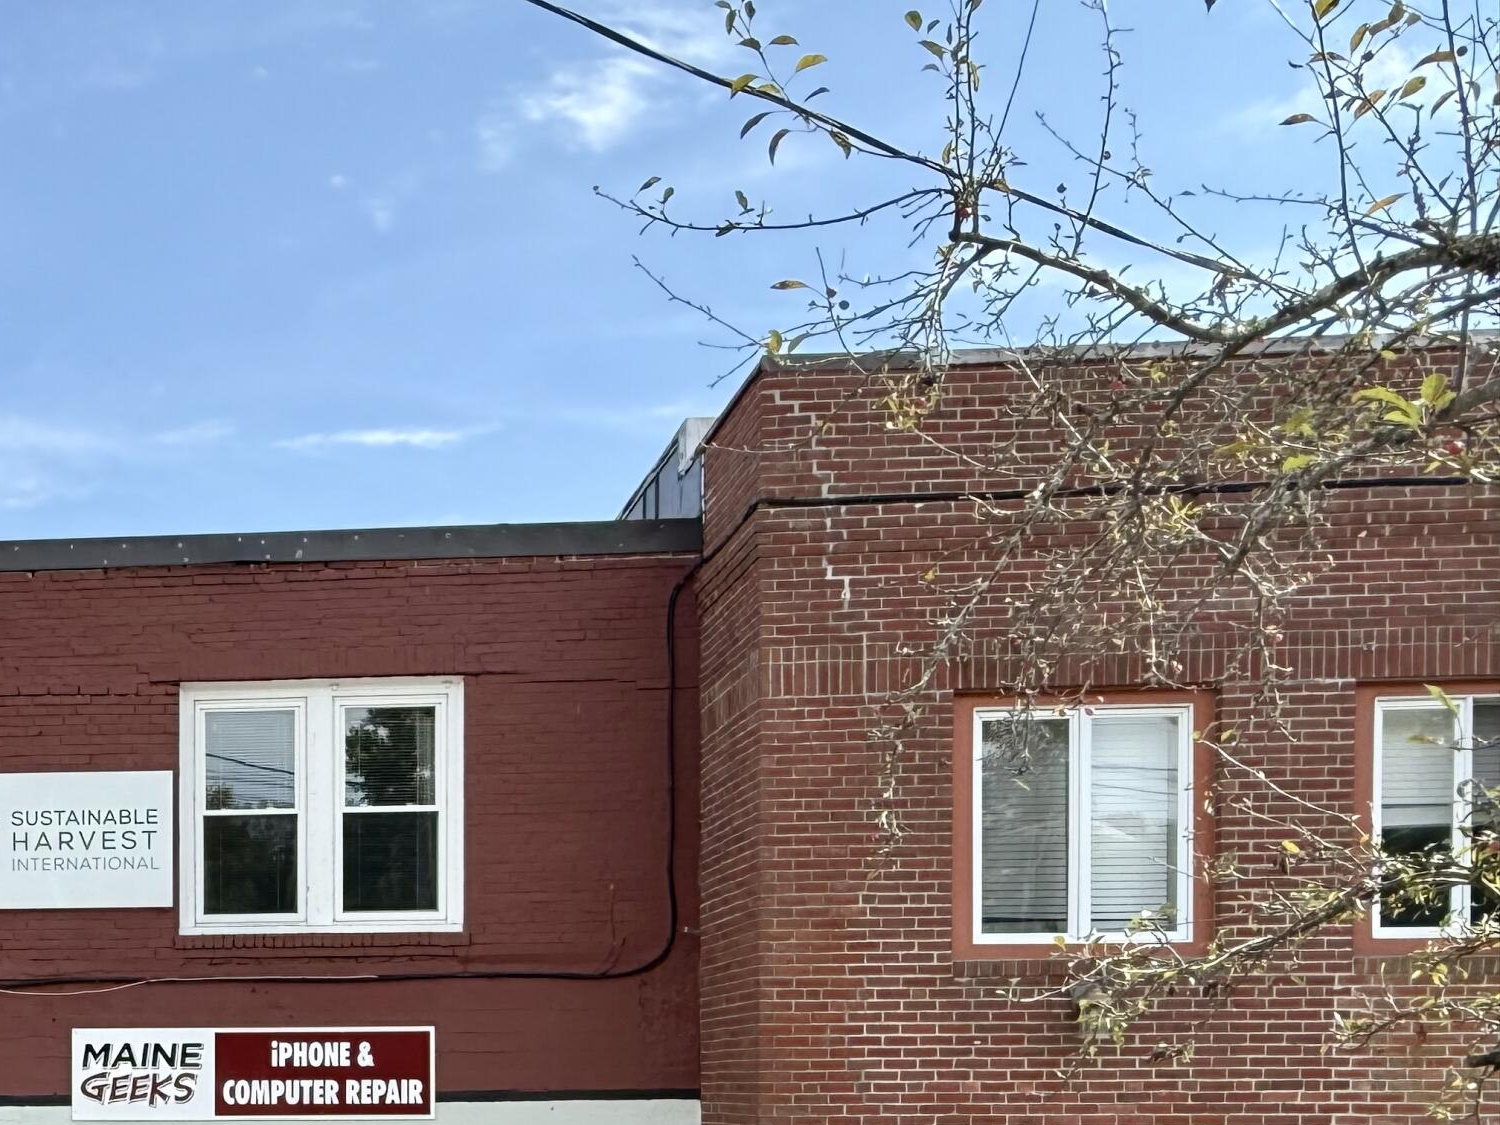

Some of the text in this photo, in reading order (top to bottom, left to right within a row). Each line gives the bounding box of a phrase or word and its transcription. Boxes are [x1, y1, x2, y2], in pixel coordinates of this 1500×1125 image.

[11, 809, 158, 826] SUSTAINABLE
[13, 830, 158, 851] HARVEST
[11, 856, 160, 871] INTERNATIONAL
[82, 1042, 204, 1070] MAINE
[271, 1041, 375, 1068] iPHONE &
[80, 1072, 198, 1108] GEEKS
[222, 1079, 423, 1106] COMPUTER REPAIR
